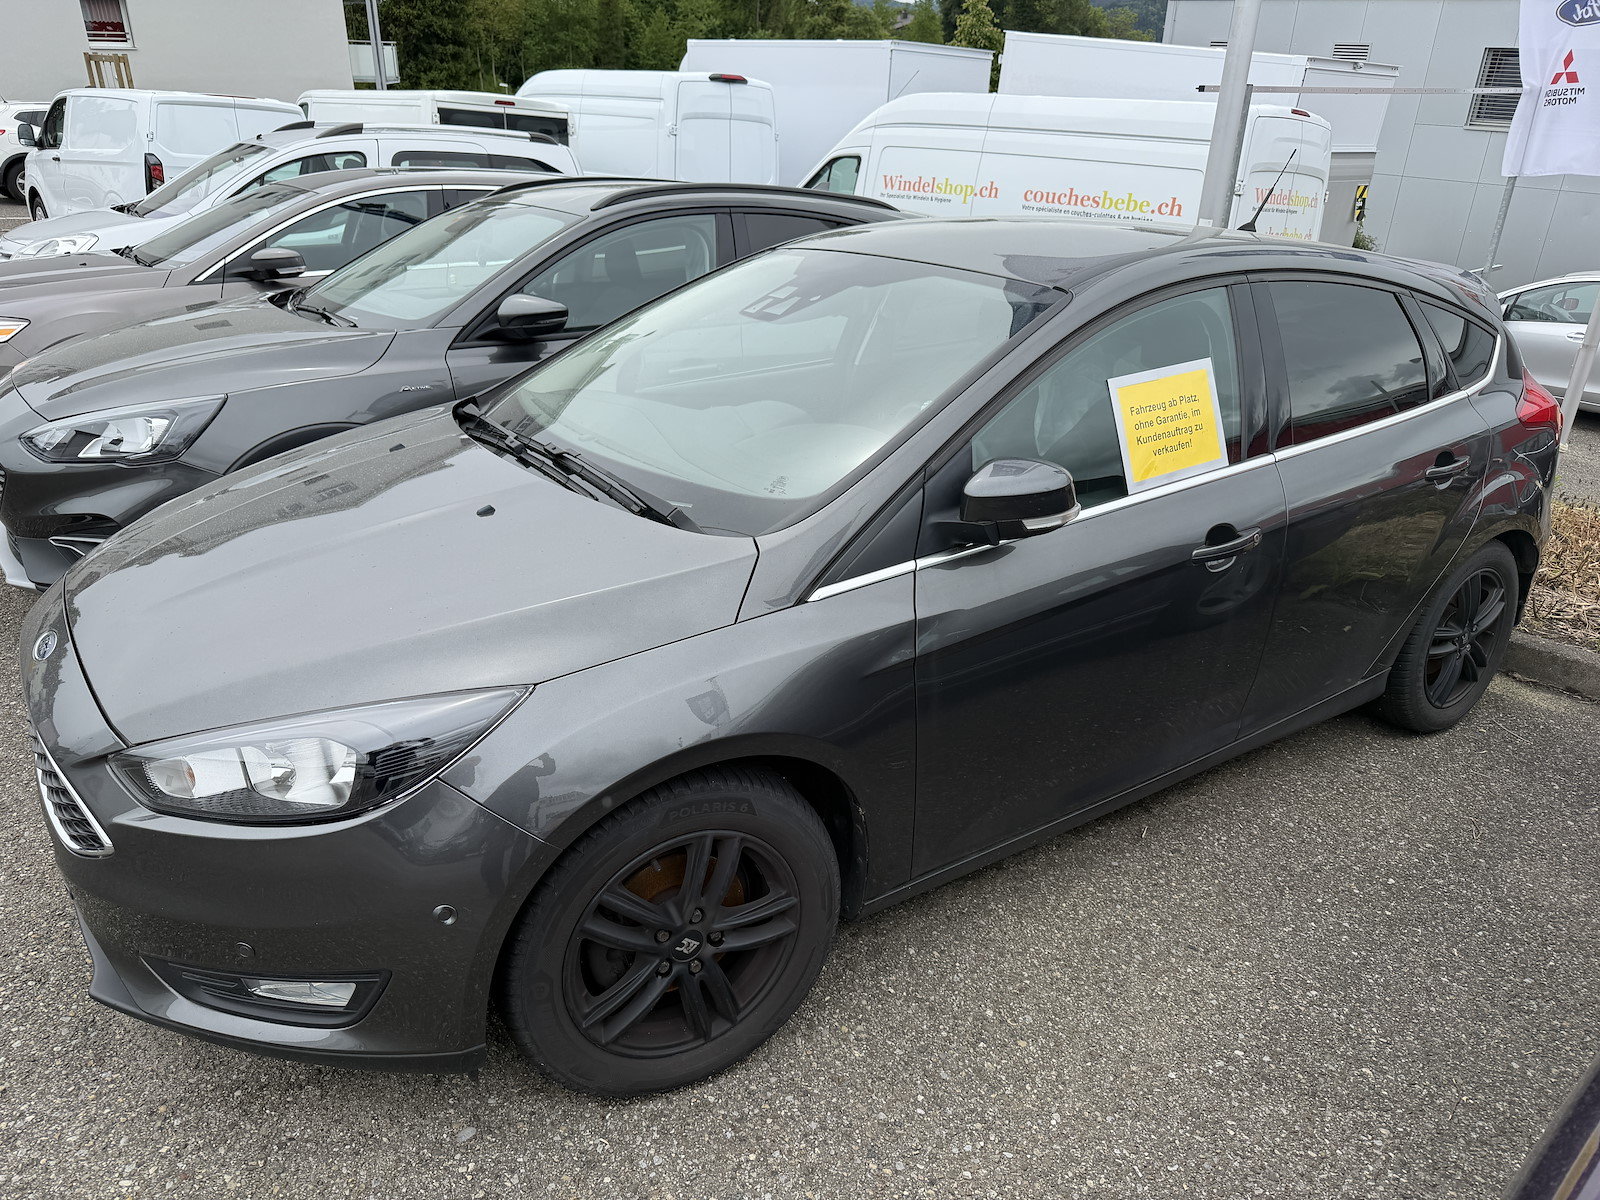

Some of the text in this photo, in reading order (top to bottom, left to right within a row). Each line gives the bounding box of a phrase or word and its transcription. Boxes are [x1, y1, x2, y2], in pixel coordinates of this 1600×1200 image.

[883, 174, 999, 204] Windelshop.ch
[1023, 187, 1182, 217] couchesbebe.ch
[1035, 205, 1062, 214] spécialiste
[1255, 187, 1318, 215] Wndelshop.ch
[1129, 394, 1200, 416] Fahrzeug ab Platz,
[1134, 408, 1201, 431] ohne Garantie, im
[1136, 423, 1204, 446] Kundenauftrag zu
[1152, 439, 1193, 457] verkaufen!
[670, 801, 736, 818] POLARIS
